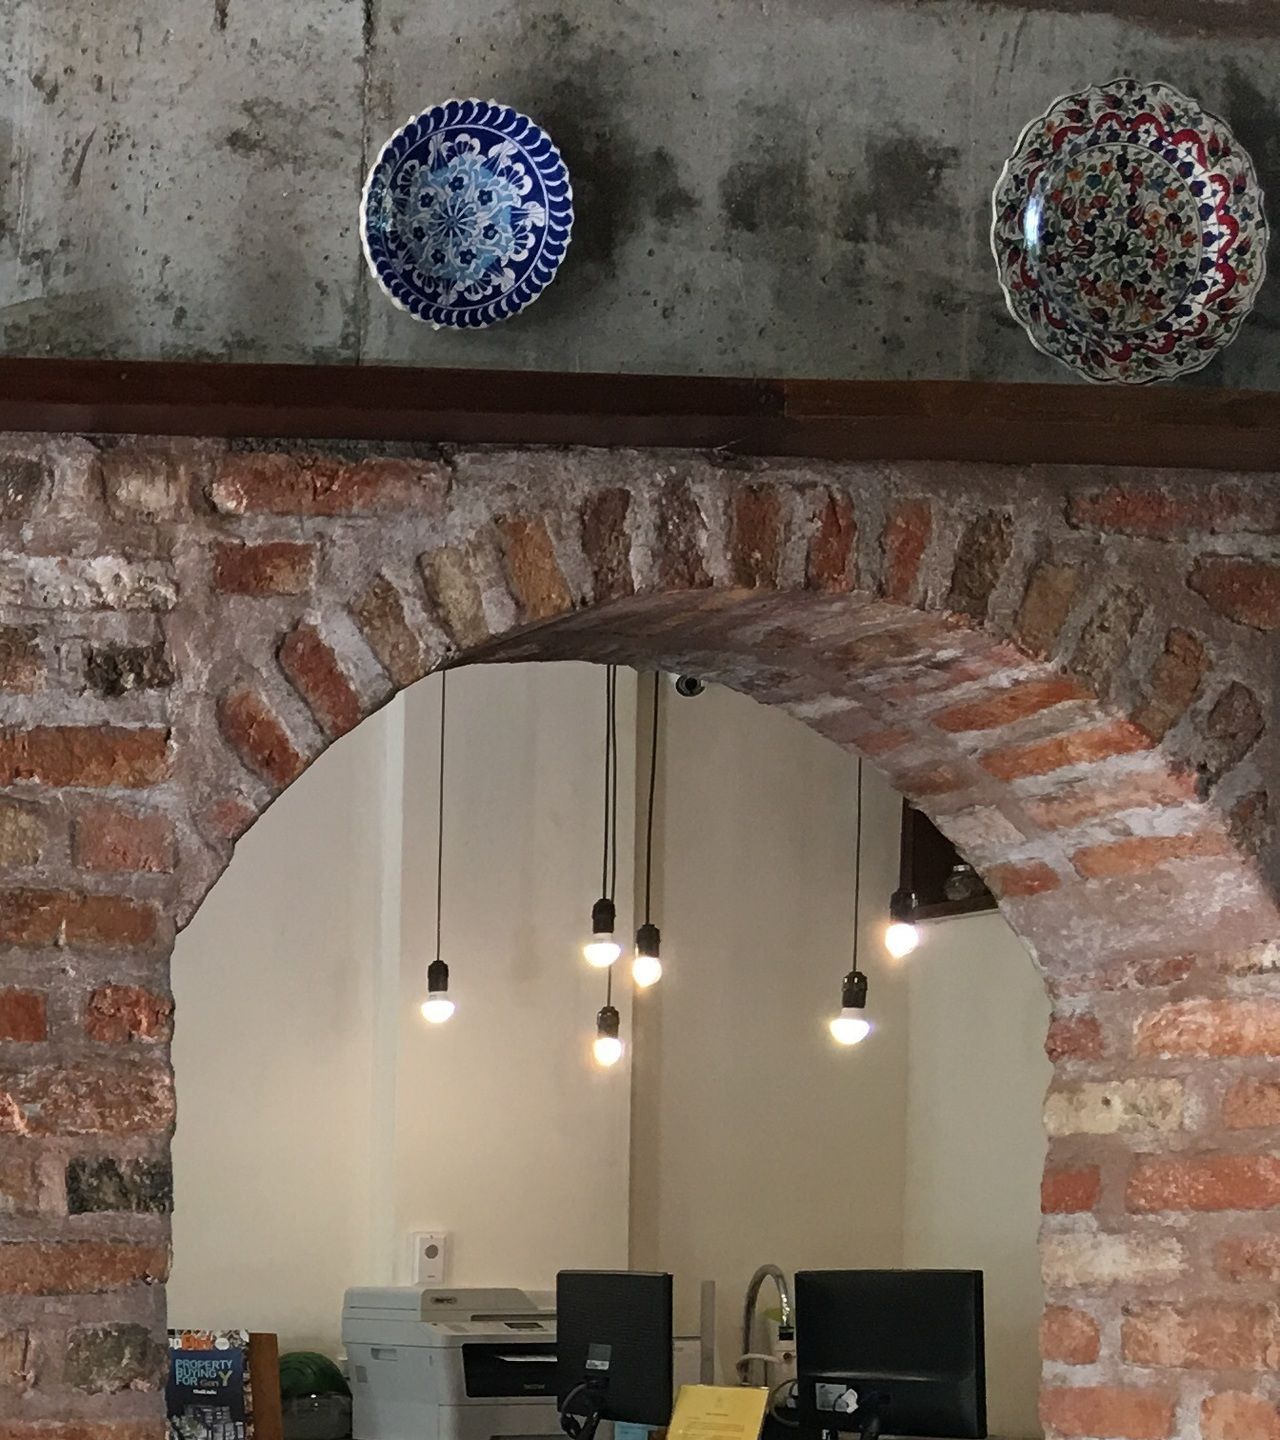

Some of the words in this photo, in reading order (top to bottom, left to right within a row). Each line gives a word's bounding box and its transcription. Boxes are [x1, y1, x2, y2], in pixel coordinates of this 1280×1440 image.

[175, 1359, 233, 1370] PROPERTY
[175, 1367, 217, 1378] BUYING
[175, 1376, 198, 1386] FOR
[219, 1370, 233, 1387] Y
